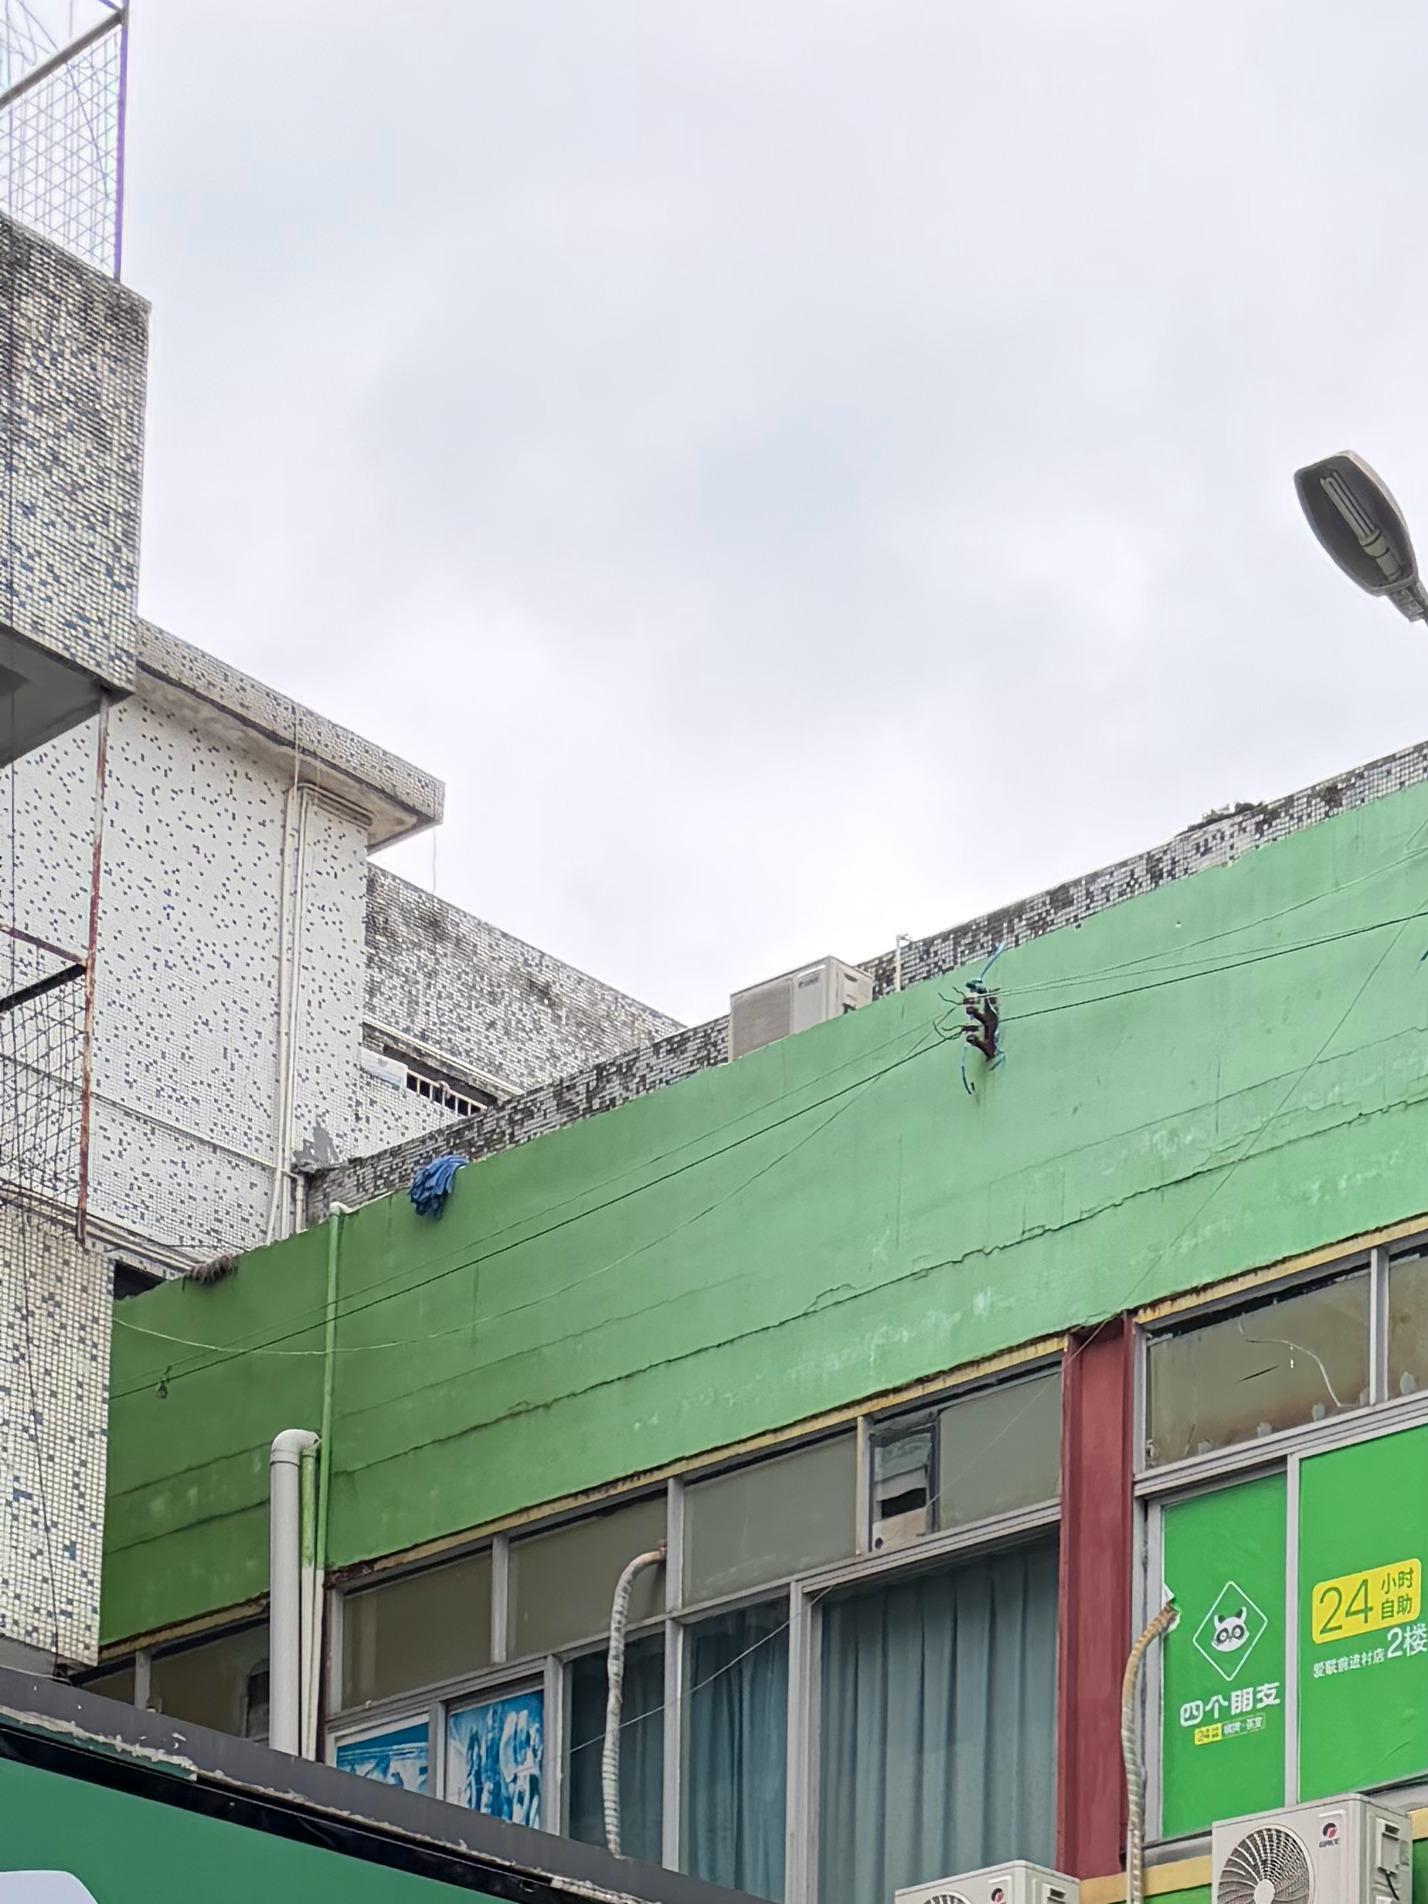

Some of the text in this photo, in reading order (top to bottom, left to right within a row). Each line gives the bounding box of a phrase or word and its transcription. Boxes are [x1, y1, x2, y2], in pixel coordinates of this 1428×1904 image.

[1380, 1567, 1414, 1594] 小时
[1319, 1579, 1374, 1636] 24
[1380, 1597, 1413, 1621] 自助
[1387, 1623, 1428, 1659] 2楼
[1180, 1682, 1280, 1727] 四个朋友
